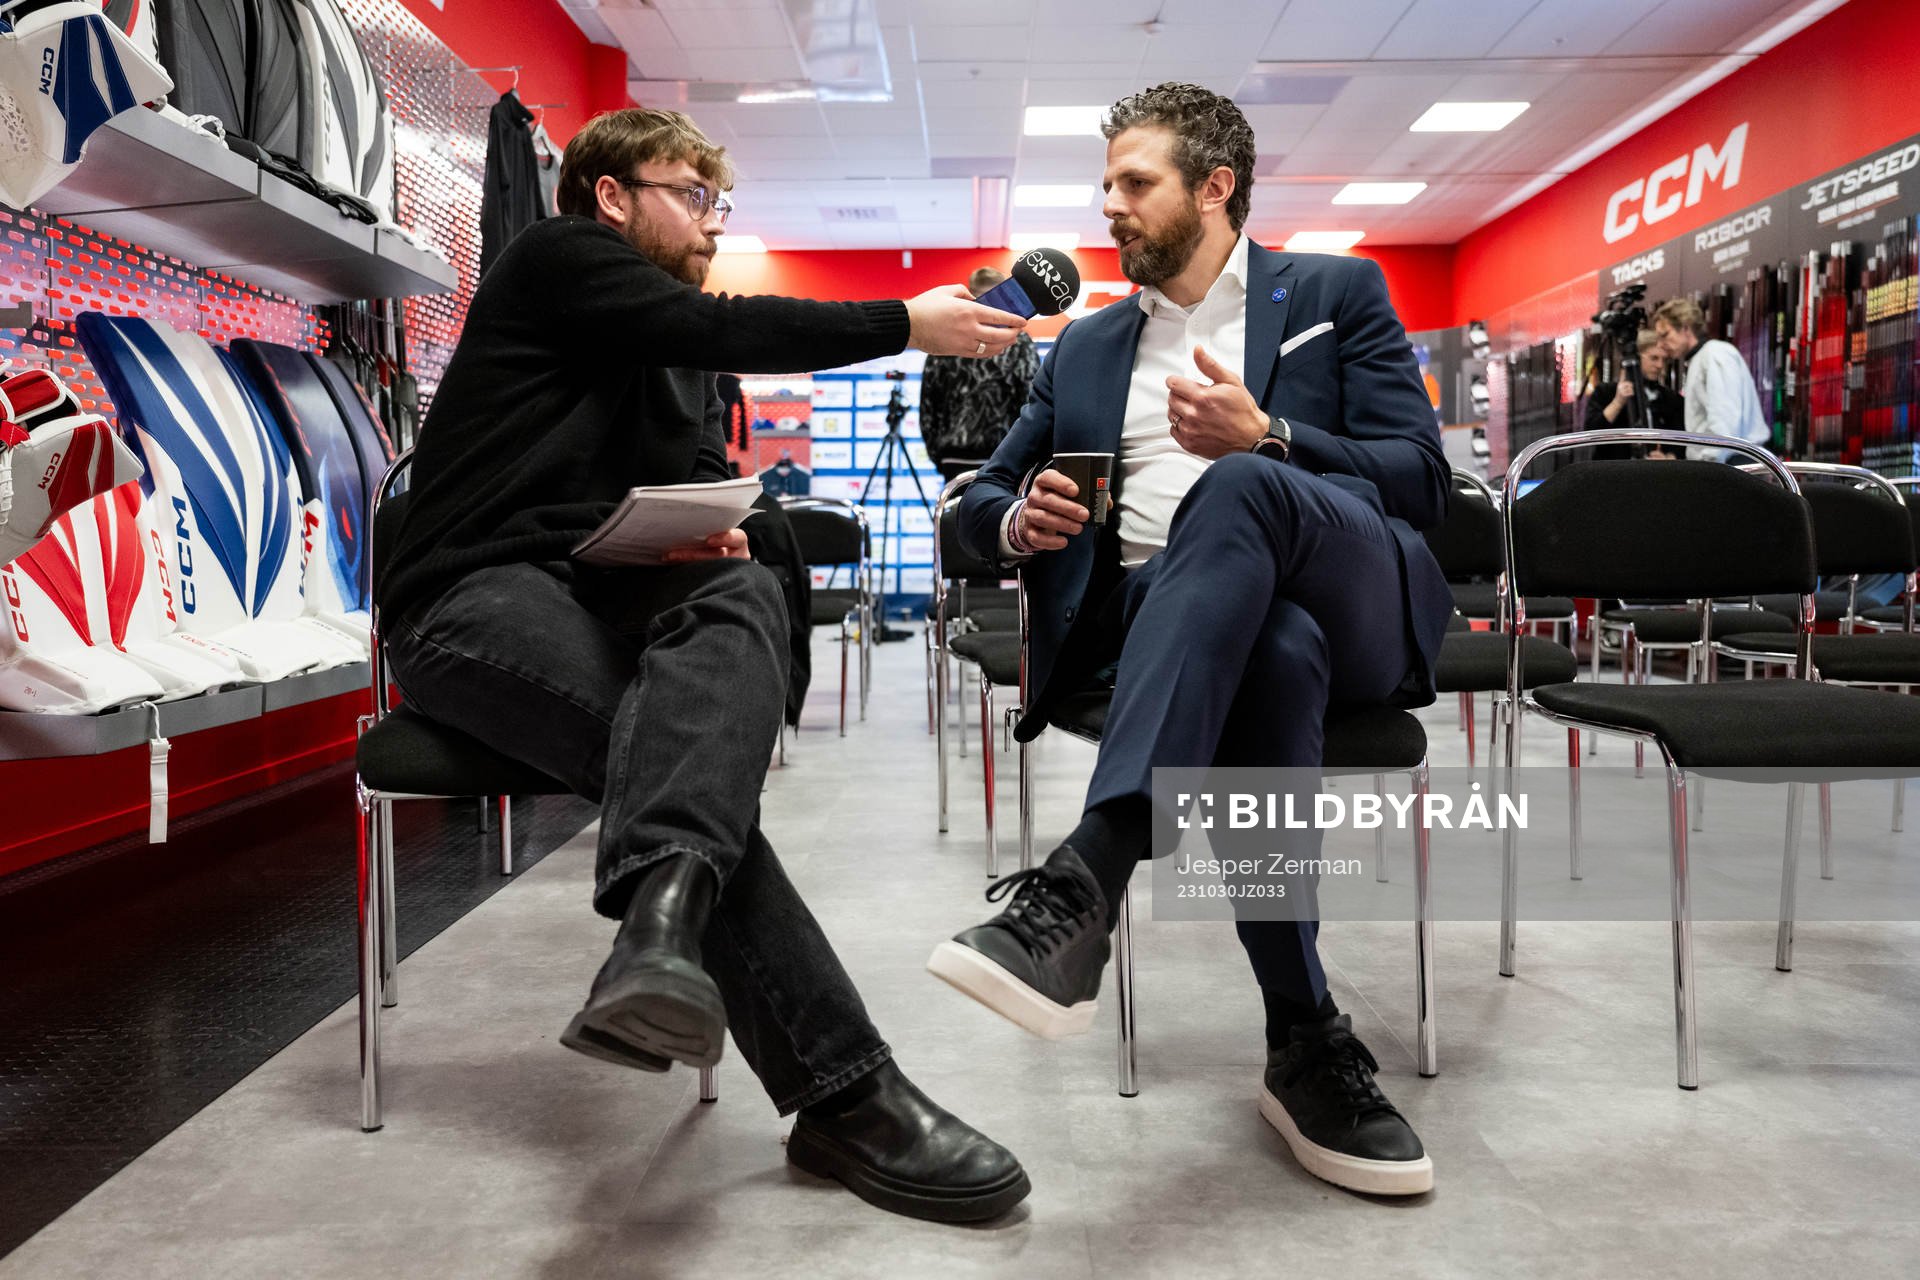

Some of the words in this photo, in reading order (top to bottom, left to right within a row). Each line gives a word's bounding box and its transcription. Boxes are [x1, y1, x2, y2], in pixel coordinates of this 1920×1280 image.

[39, 47, 54, 95] CCM
[1603, 122, 1748, 244] CCM
[1801, 143, 1919, 211] JETSPEED
[1695, 205, 1771, 252] RIBCOR
[1611, 249, 1665, 285] TACKS
[38, 453, 61, 490] CCM
[150, 529, 177, 623] CCM
[172, 496, 195, 614] CCM
[2, 563, 30, 643] CC
